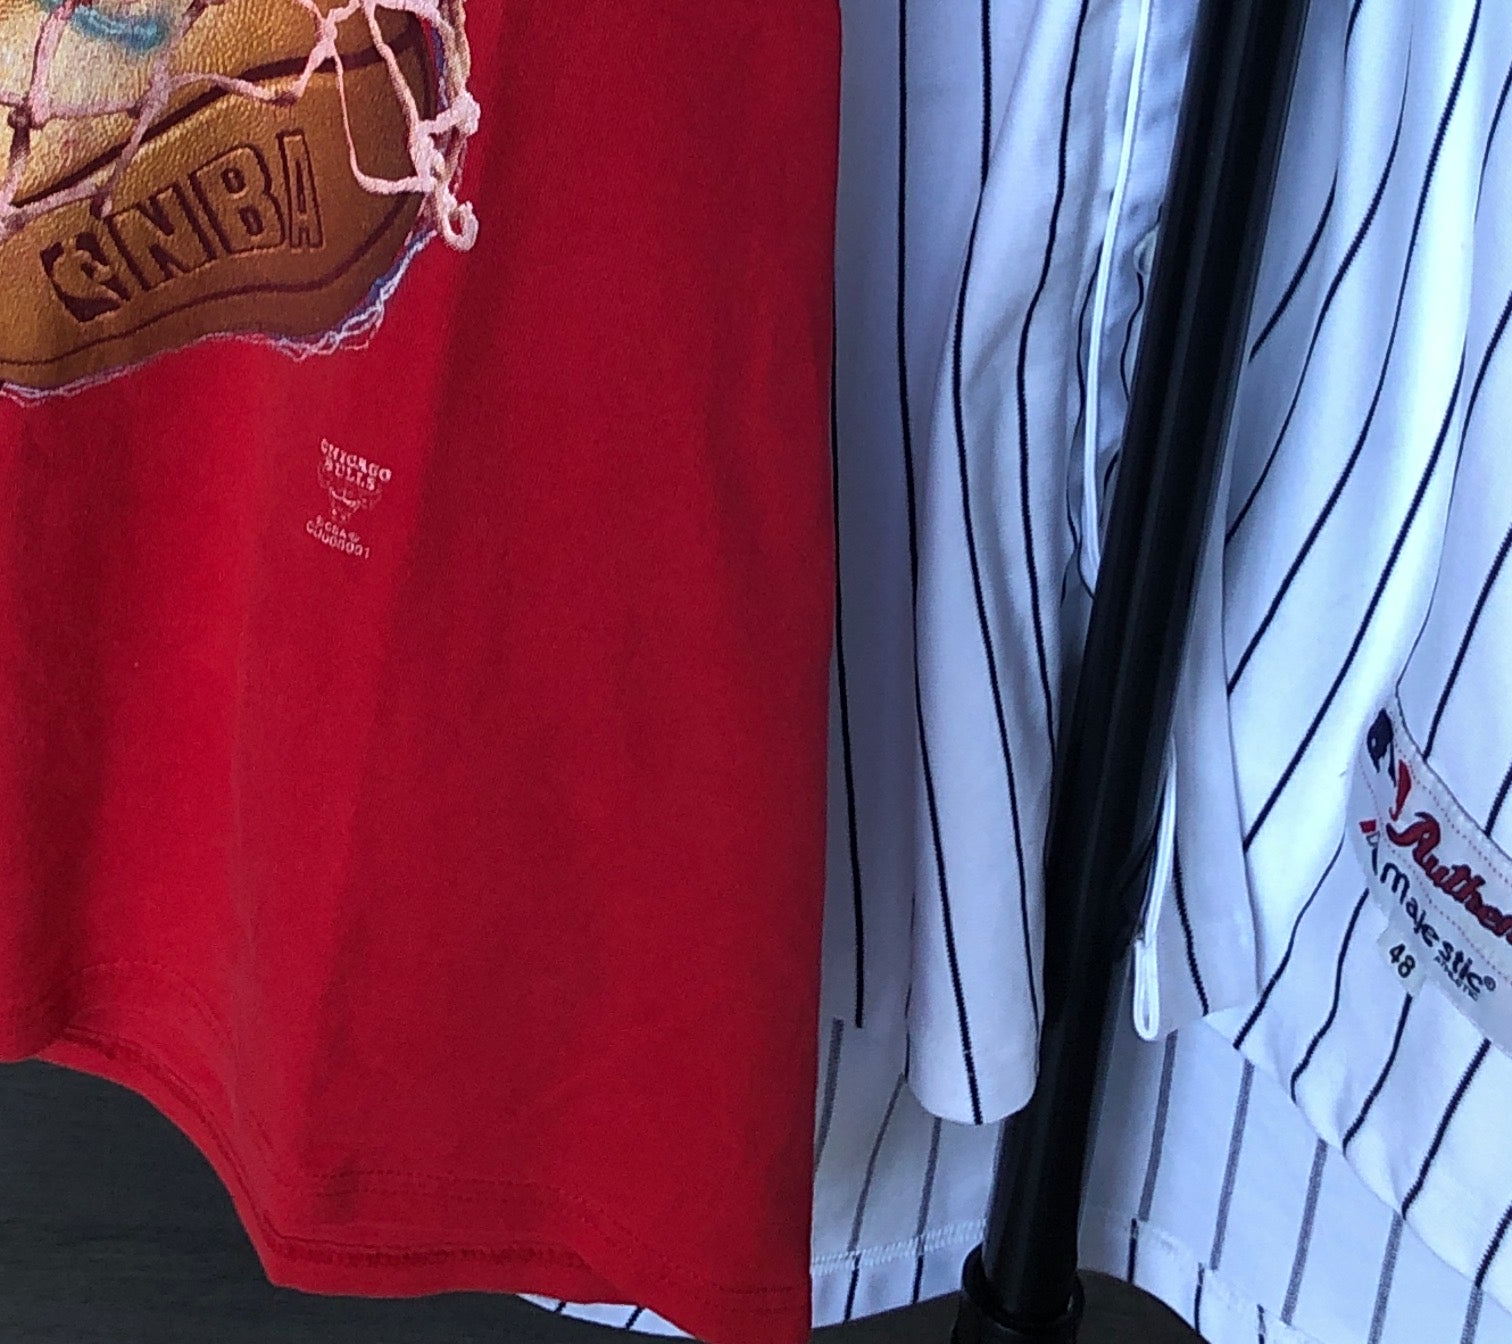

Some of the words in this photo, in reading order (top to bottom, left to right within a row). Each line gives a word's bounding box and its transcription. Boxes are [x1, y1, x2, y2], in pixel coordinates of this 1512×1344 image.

[106, 129, 325, 289] NBA
[321, 438, 392, 482] CHICAGO
[324, 456, 375, 491] BULLS
[1389, 943, 1416, 980] 48
